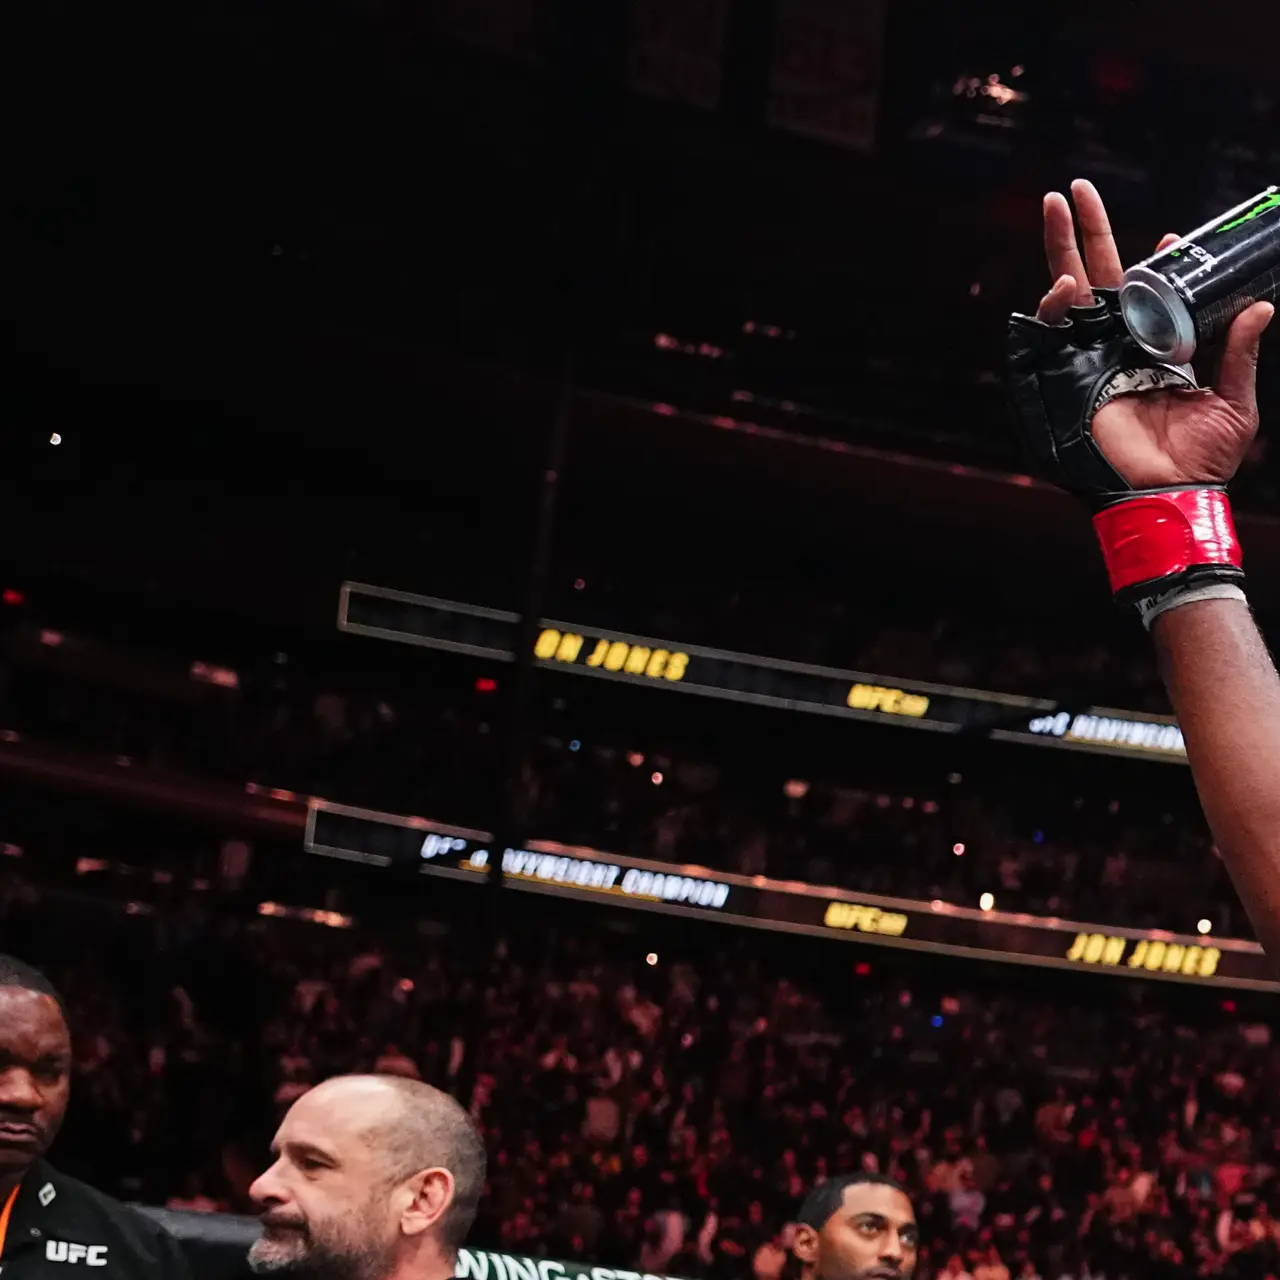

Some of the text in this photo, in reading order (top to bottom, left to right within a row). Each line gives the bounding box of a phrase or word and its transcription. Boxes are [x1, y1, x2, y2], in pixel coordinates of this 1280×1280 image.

[533, 628, 691, 682] ON JONES
[1066, 931, 1222, 978] JON JONES
[46, 1239, 109, 1267] UFC
